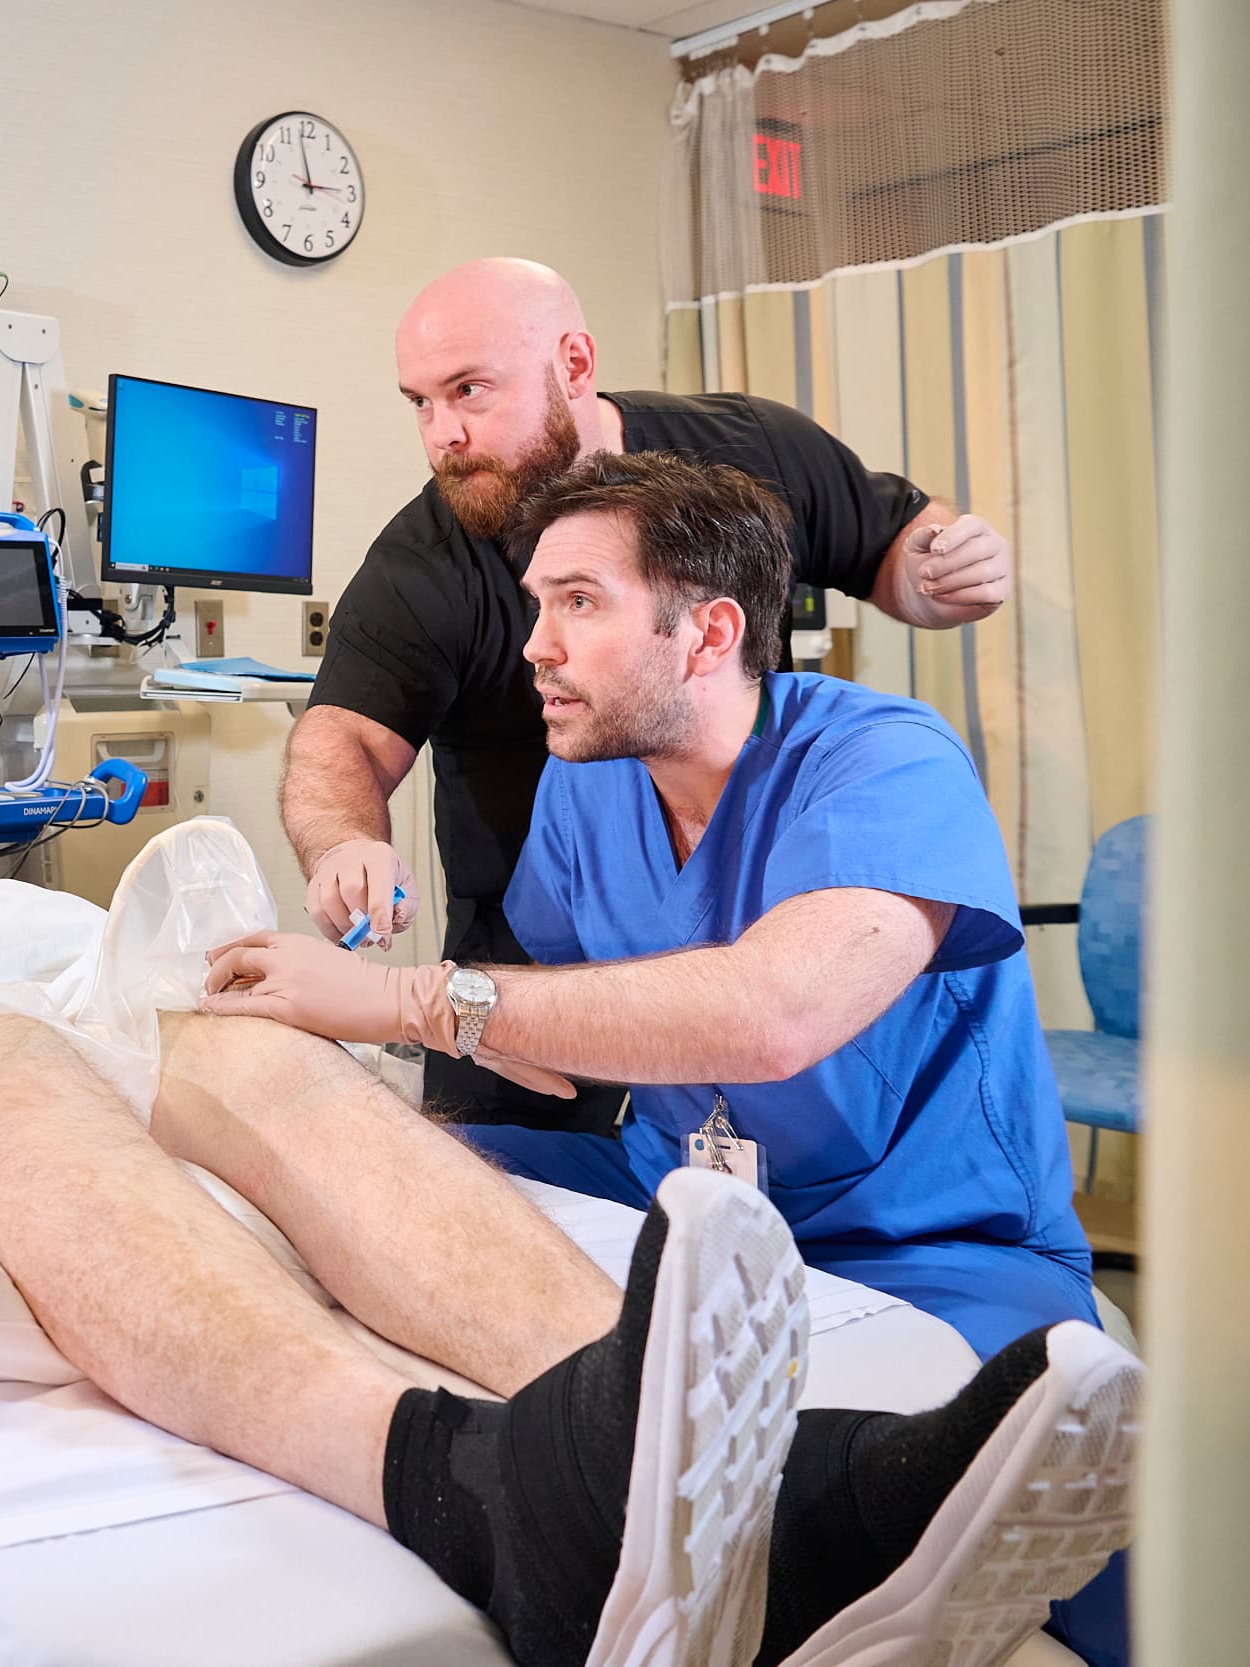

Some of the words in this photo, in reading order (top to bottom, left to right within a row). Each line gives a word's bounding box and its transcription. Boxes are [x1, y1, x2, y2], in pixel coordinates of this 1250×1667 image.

[279, 126, 292, 145] 11
[300, 120, 316, 140] 12
[325, 133, 331, 151] 1
[259, 143, 276, 163] 10
[340, 156, 350, 174] 2
[753, 133, 801, 199] EXIT
[255, 171, 266, 189] 9
[347, 185, 357, 203] 3
[263, 199, 274, 218] 8
[340, 211, 350, 228] 4
[282, 224, 292, 243] 7
[325, 230, 335, 248] 5
[304, 234, 314, 252] 6
[23, 806, 55, 816] DINAMAP
